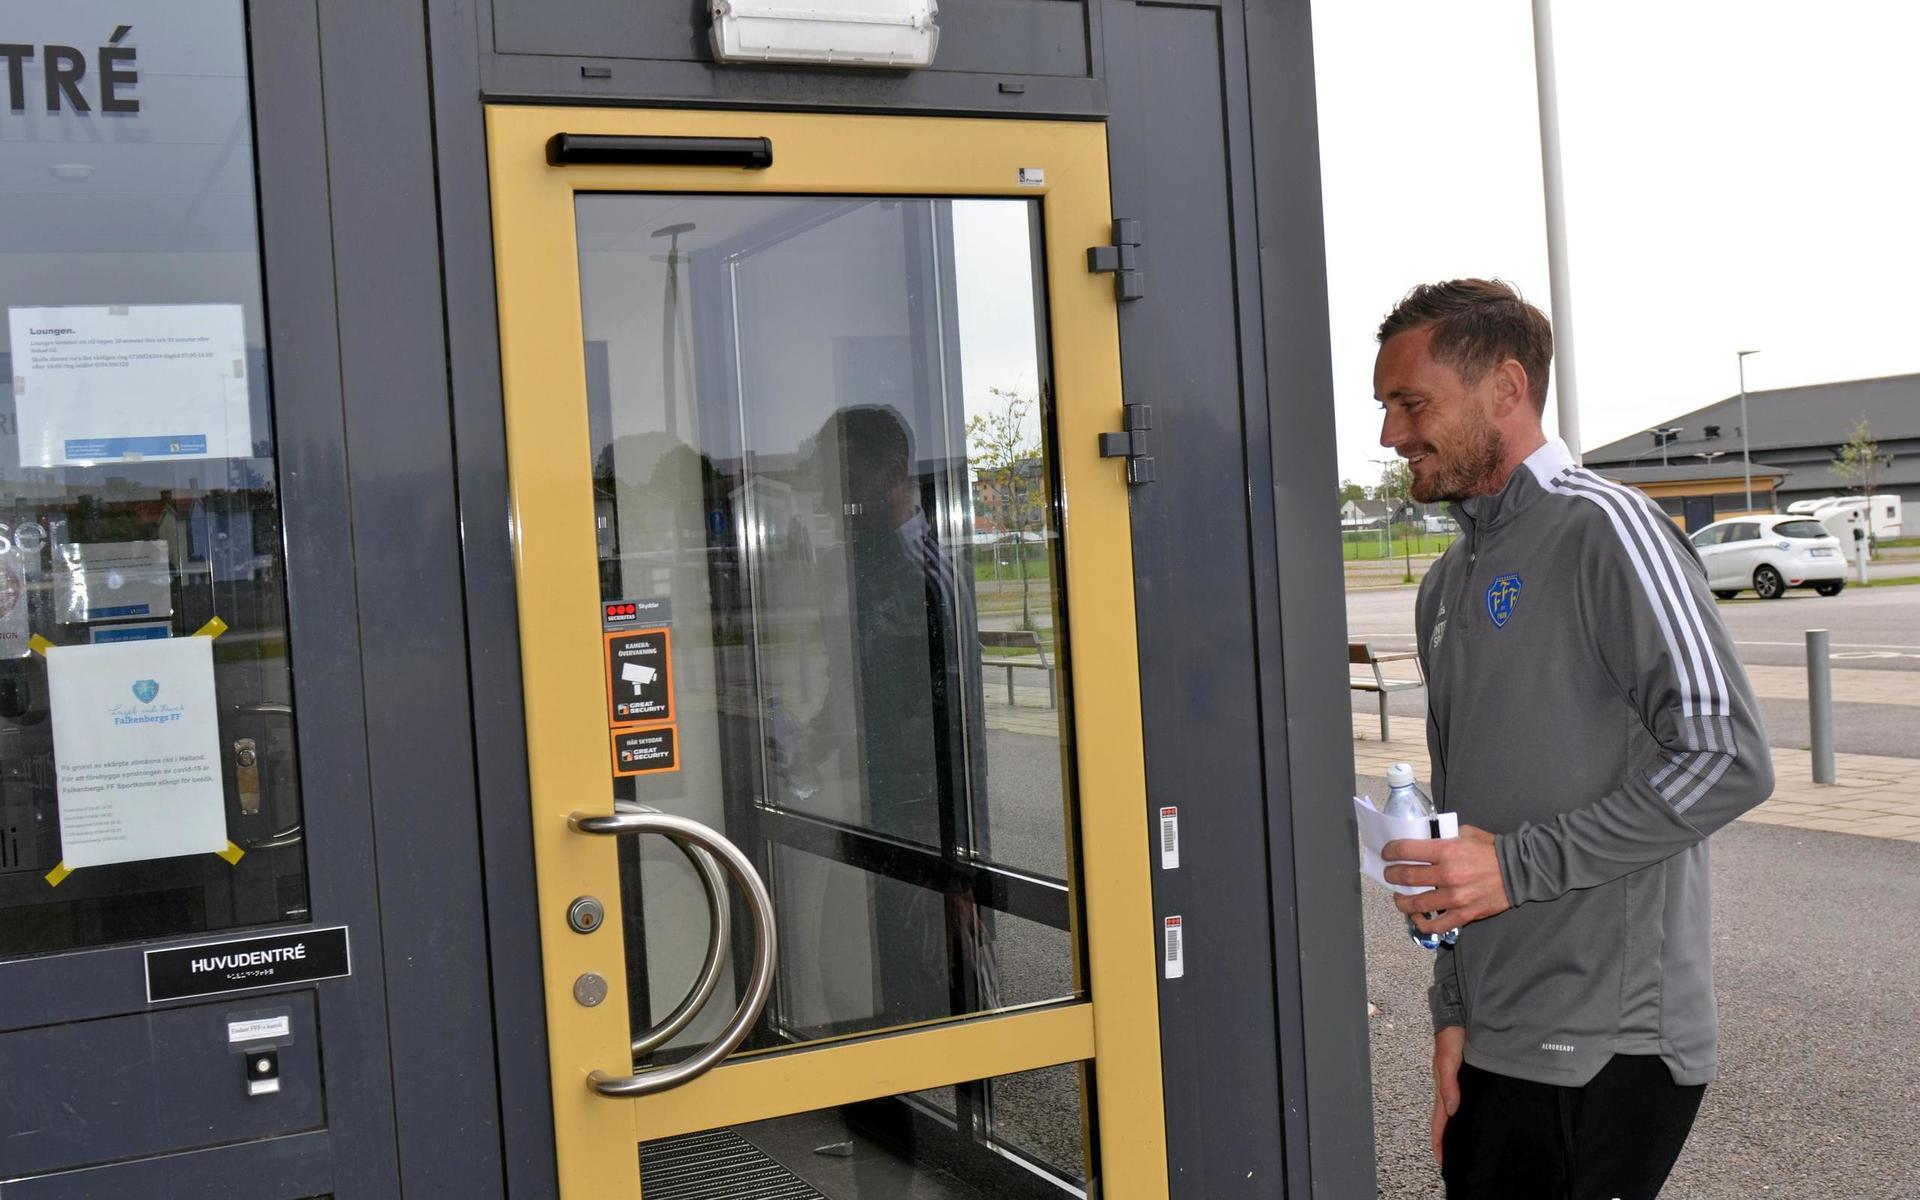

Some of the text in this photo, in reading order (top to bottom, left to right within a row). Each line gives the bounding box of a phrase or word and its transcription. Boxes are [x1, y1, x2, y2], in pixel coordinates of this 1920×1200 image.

[0, 25, 139, 113] TRÉ
[607, 614, 636, 622] SECURITAS
[630, 701, 655, 709] GREAT
[630, 705, 667, 714] SECURITY
[633, 747, 658, 755] GREAT
[633, 751, 670, 761] SECURITY
[191, 943, 306, 973] HUVUDENTRÉ
